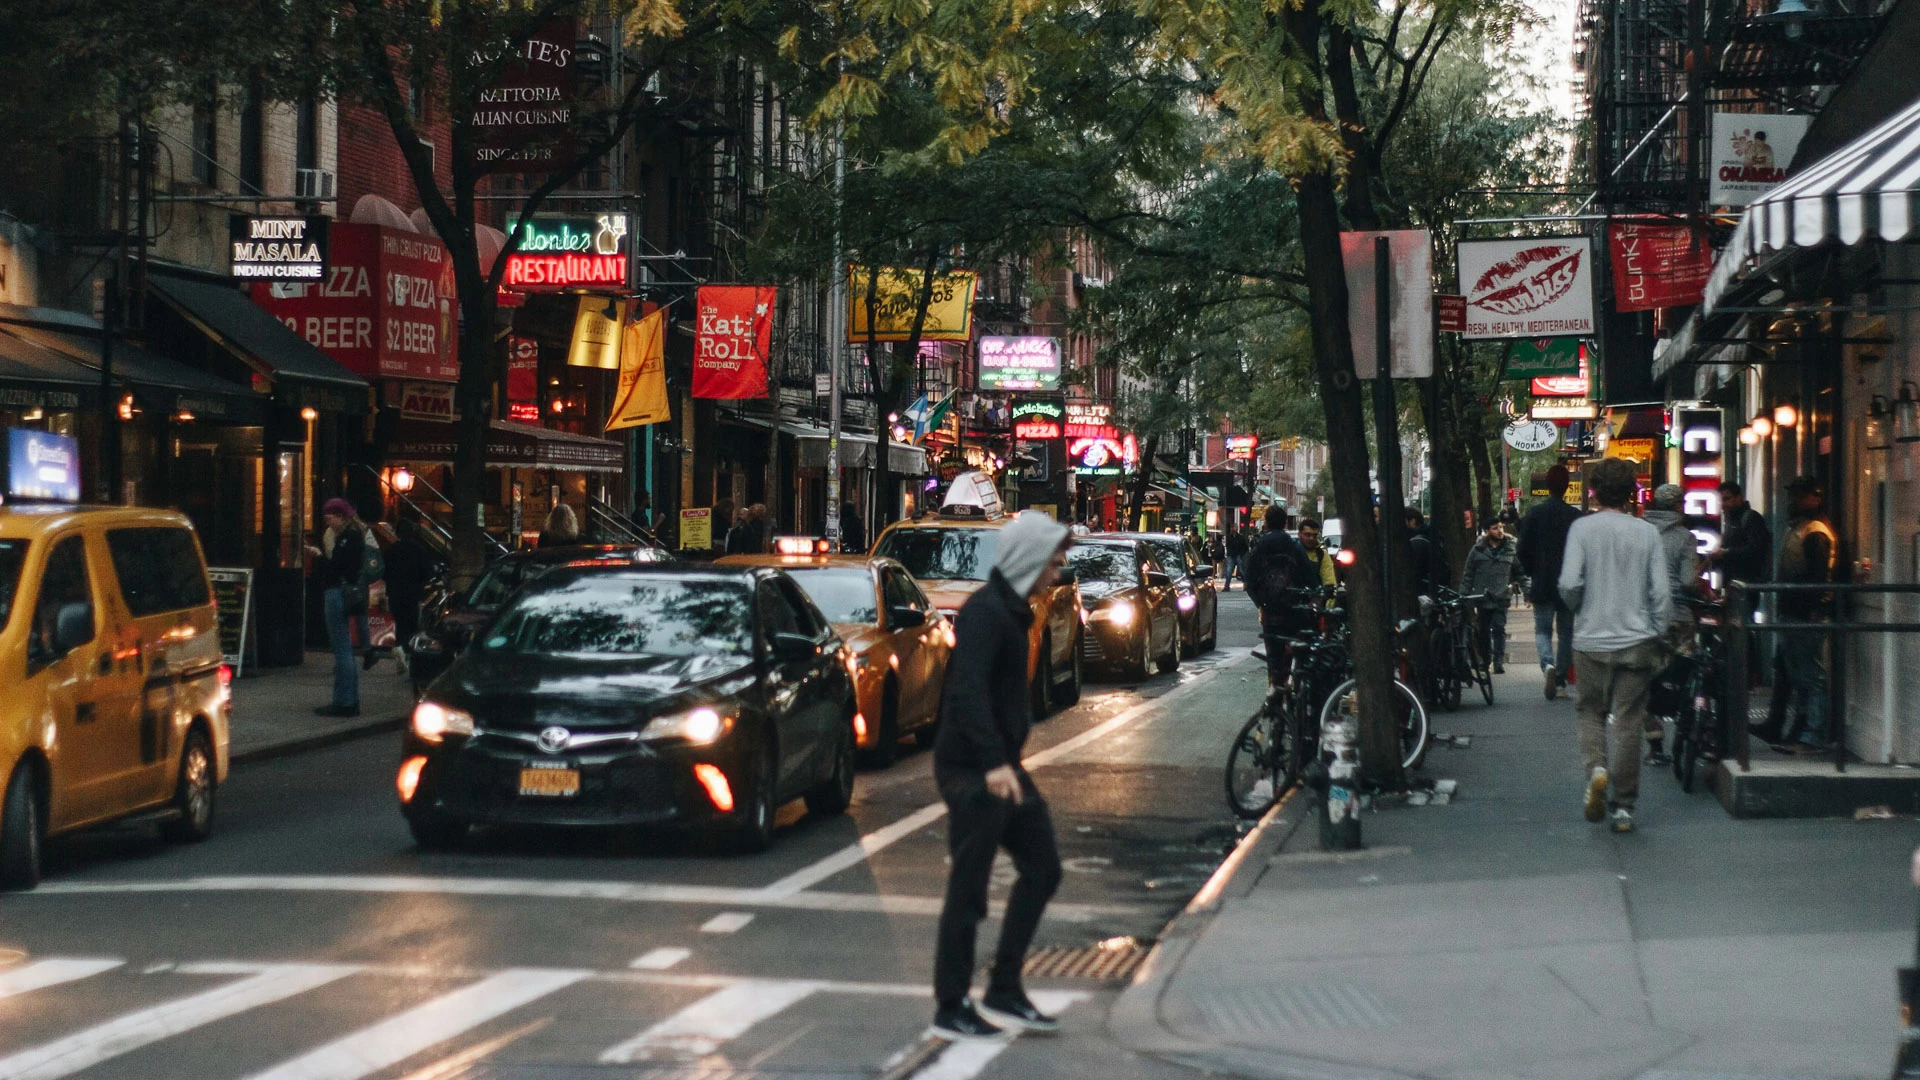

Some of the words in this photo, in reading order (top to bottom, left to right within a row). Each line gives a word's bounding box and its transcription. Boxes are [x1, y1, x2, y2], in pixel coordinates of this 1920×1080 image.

[478, 88, 562, 103] RATTORIA
[472, 111, 512, 126] ALIAN
[514, 109, 570, 125] CUISINE
[251, 220, 306, 239] MINT
[234, 243, 323, 262] MASALA
[383, 235, 399, 256] THIN
[400, 239, 423, 259] CRUST
[423, 244, 442, 264] PIZZA
[233, 265, 274, 278] INDIAN
[274, 265, 323, 278] CUISINE
[511, 256, 627, 285] RESTAURANT
[404, 273, 436, 310] PIZZA
[701, 306, 717, 314] The
[304, 316, 371, 349] BEER
[700, 314, 756, 337] Kati
[1492, 321, 1527, 335] HEALTHY.
[1528, 319, 1592, 333] MEDITERRANEAN.
[402, 321, 436, 356] BEER
[699, 337, 755, 360] Roll
[698, 359, 741, 372] Company
[404, 395, 451, 415] ATM
[1012, 403, 1062, 419] Artichoke
[1015, 423, 1058, 439] PIZZA
[1514, 440, 1546, 450] HOOKAH
